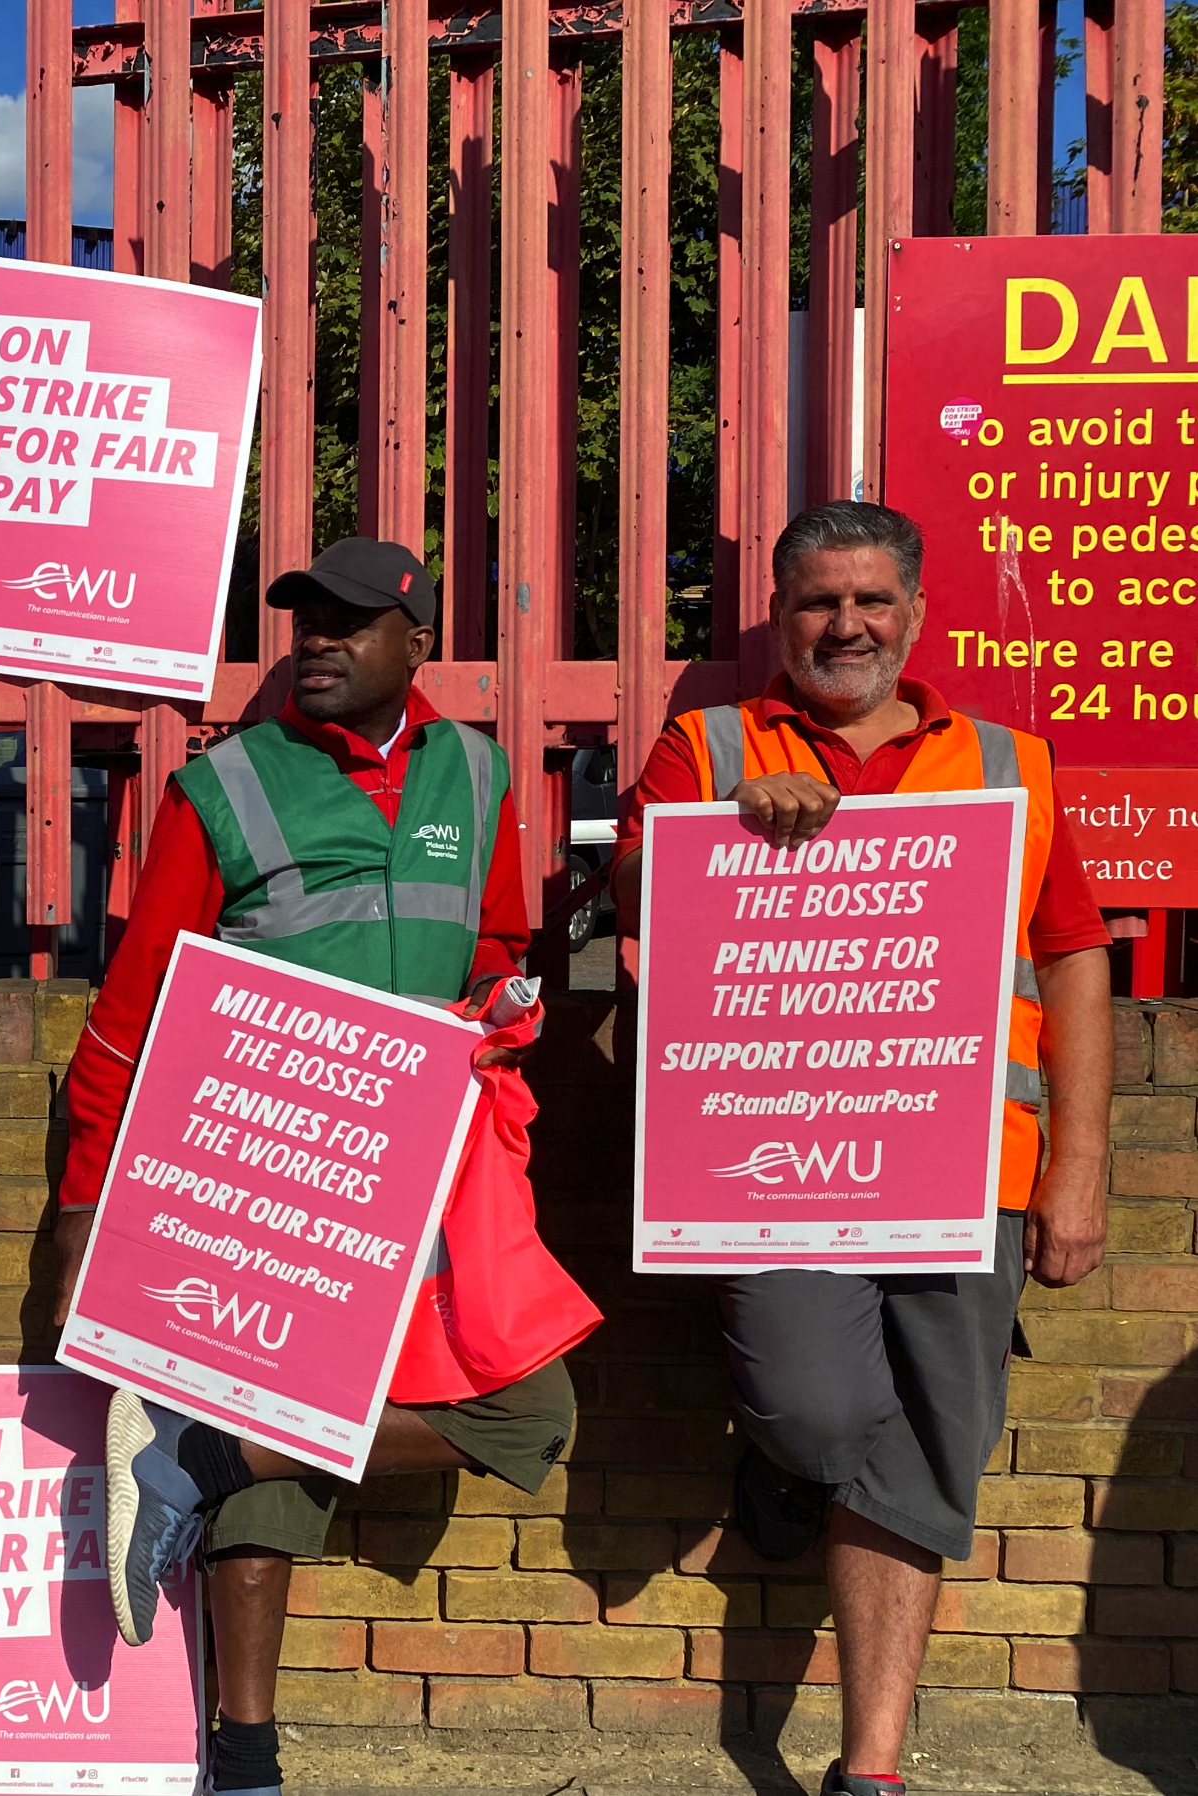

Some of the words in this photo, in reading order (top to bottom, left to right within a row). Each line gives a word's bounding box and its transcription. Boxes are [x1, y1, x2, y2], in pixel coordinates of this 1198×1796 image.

[1006, 277, 1198, 364] DA
[0, 326, 70, 365] ON
[1029, 408, 1152, 445] avoid
[91, 433, 196, 475] FAIR
[968, 471, 1016, 499] or
[1040, 462, 1170, 506] injury
[979, 516, 1052, 552] the
[30, 562, 136, 608] CWU
[1048, 570, 1094, 605] to
[1119, 577, 1197, 606] acc
[27, 603, 42, 613] The
[42, 607, 106, 622] communications
[106, 615, 130, 625] union
[948, 631, 1078, 667] There
[1101, 640, 1174, 668] are
[1050, 684, 1111, 719] 24
[1134, 684, 1198, 720] ho
[419, 824, 459, 841] CWU
[707, 838, 886, 876] MILLIONS
[889, 835, 957, 870] FOR
[735, 886, 797, 919] THE
[801, 881, 928, 917] BOSSES
[713, 938, 869, 974] PENNIES
[872, 936, 939, 969] FOR
[713, 985, 776, 1017] THE
[780, 979, 940, 1015] WORKERS
[211, 984, 366, 1054] MILLIONS
[363, 1032, 426, 1075] FOR
[224, 1030, 281, 1072] THE
[278, 1049, 393, 1107] BOSSES
[661, 1041, 804, 1070] SUPPORT
[807, 1040, 872, 1068] OUR
[876, 1036, 982, 1067] STRIKE
[193, 1076, 329, 1141] PENNIES
[325, 1120, 389, 1164] FOR
[702, 1090, 938, 1121] #StandByYourPost
[182, 1114, 239, 1155] THE
[238, 1133, 381, 1203] WORKERS
[748, 1141, 882, 1183] CWU
[127, 1155, 251, 1214] SUPPORT
[248, 1197, 308, 1238] OUR
[306, 1217, 405, 1270] STRIKE
[747, 1191, 766, 1200] The
[766, 1191, 849, 1200] communications
[149, 1213, 353, 1302] #StandByYourPost
[172, 1278, 293, 1349] CWU
[165, 1319, 181, 1332] The
[181, 1328, 252, 1360] communications
[252, 1355, 279, 1370] union
[43, 1531, 108, 1571] FA
[15, 1731, 85, 1740] communications
